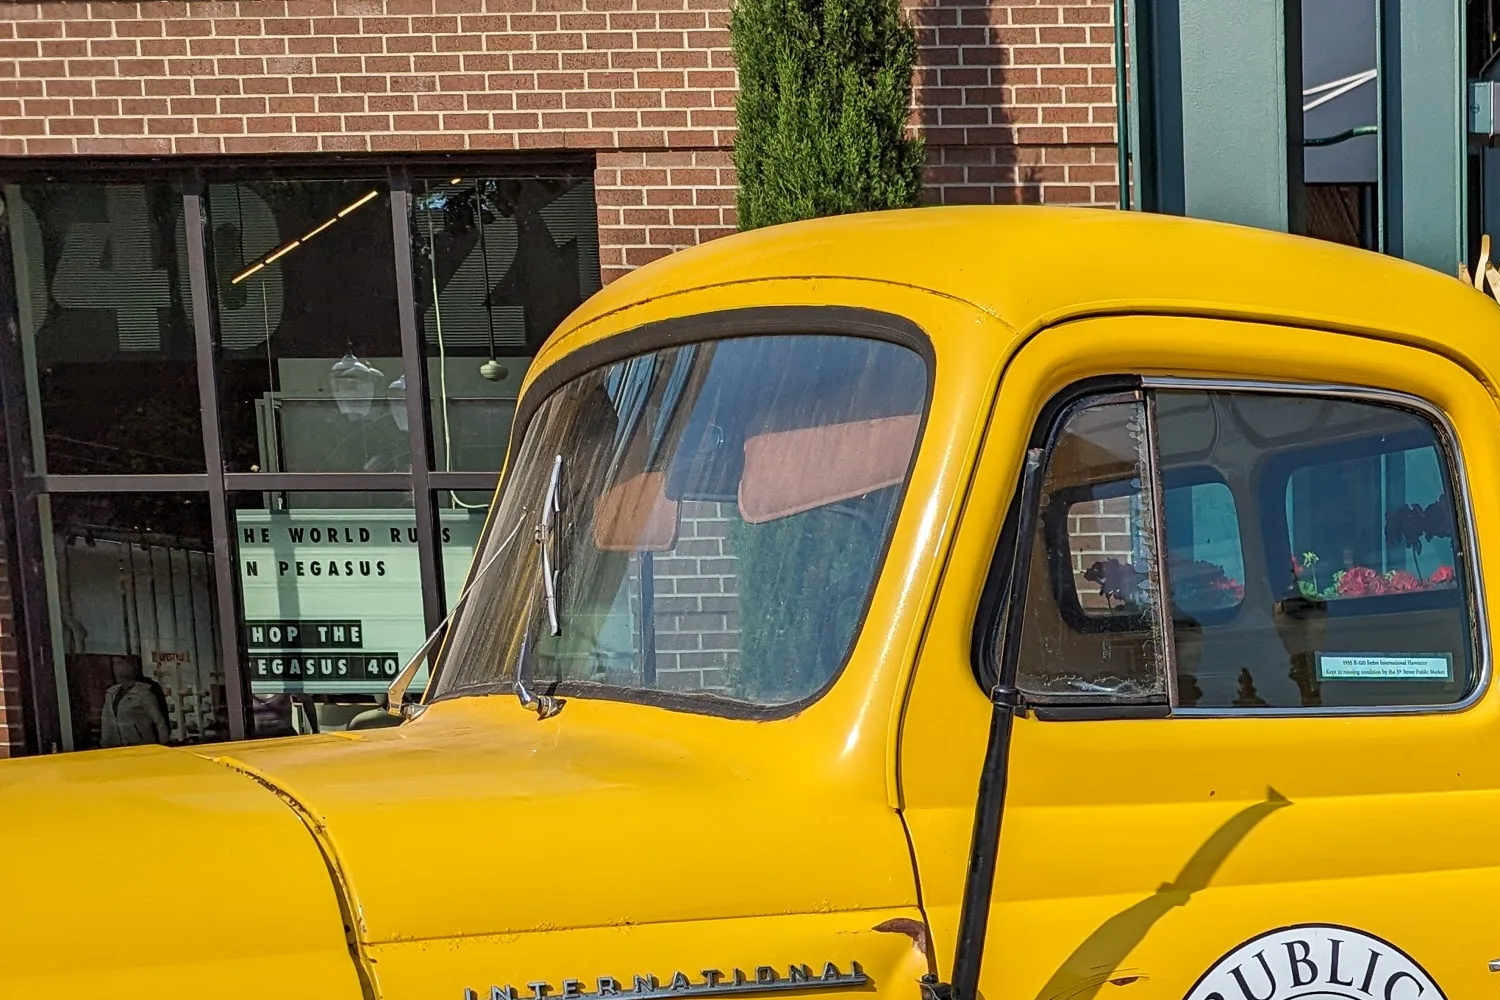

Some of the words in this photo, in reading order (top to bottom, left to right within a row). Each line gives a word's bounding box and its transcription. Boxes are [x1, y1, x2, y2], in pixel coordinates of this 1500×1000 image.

[243, 527, 270, 544] HE
[288, 527, 371, 544] WORLD
[390, 527, 451, 544] RUS
[279, 561, 386, 577] PEGASUS
[252, 626, 298, 643] HOP
[318, 626, 361, 643] THE
[249, 659, 347, 675] EGASUS
[367, 658, 397, 675] 40
